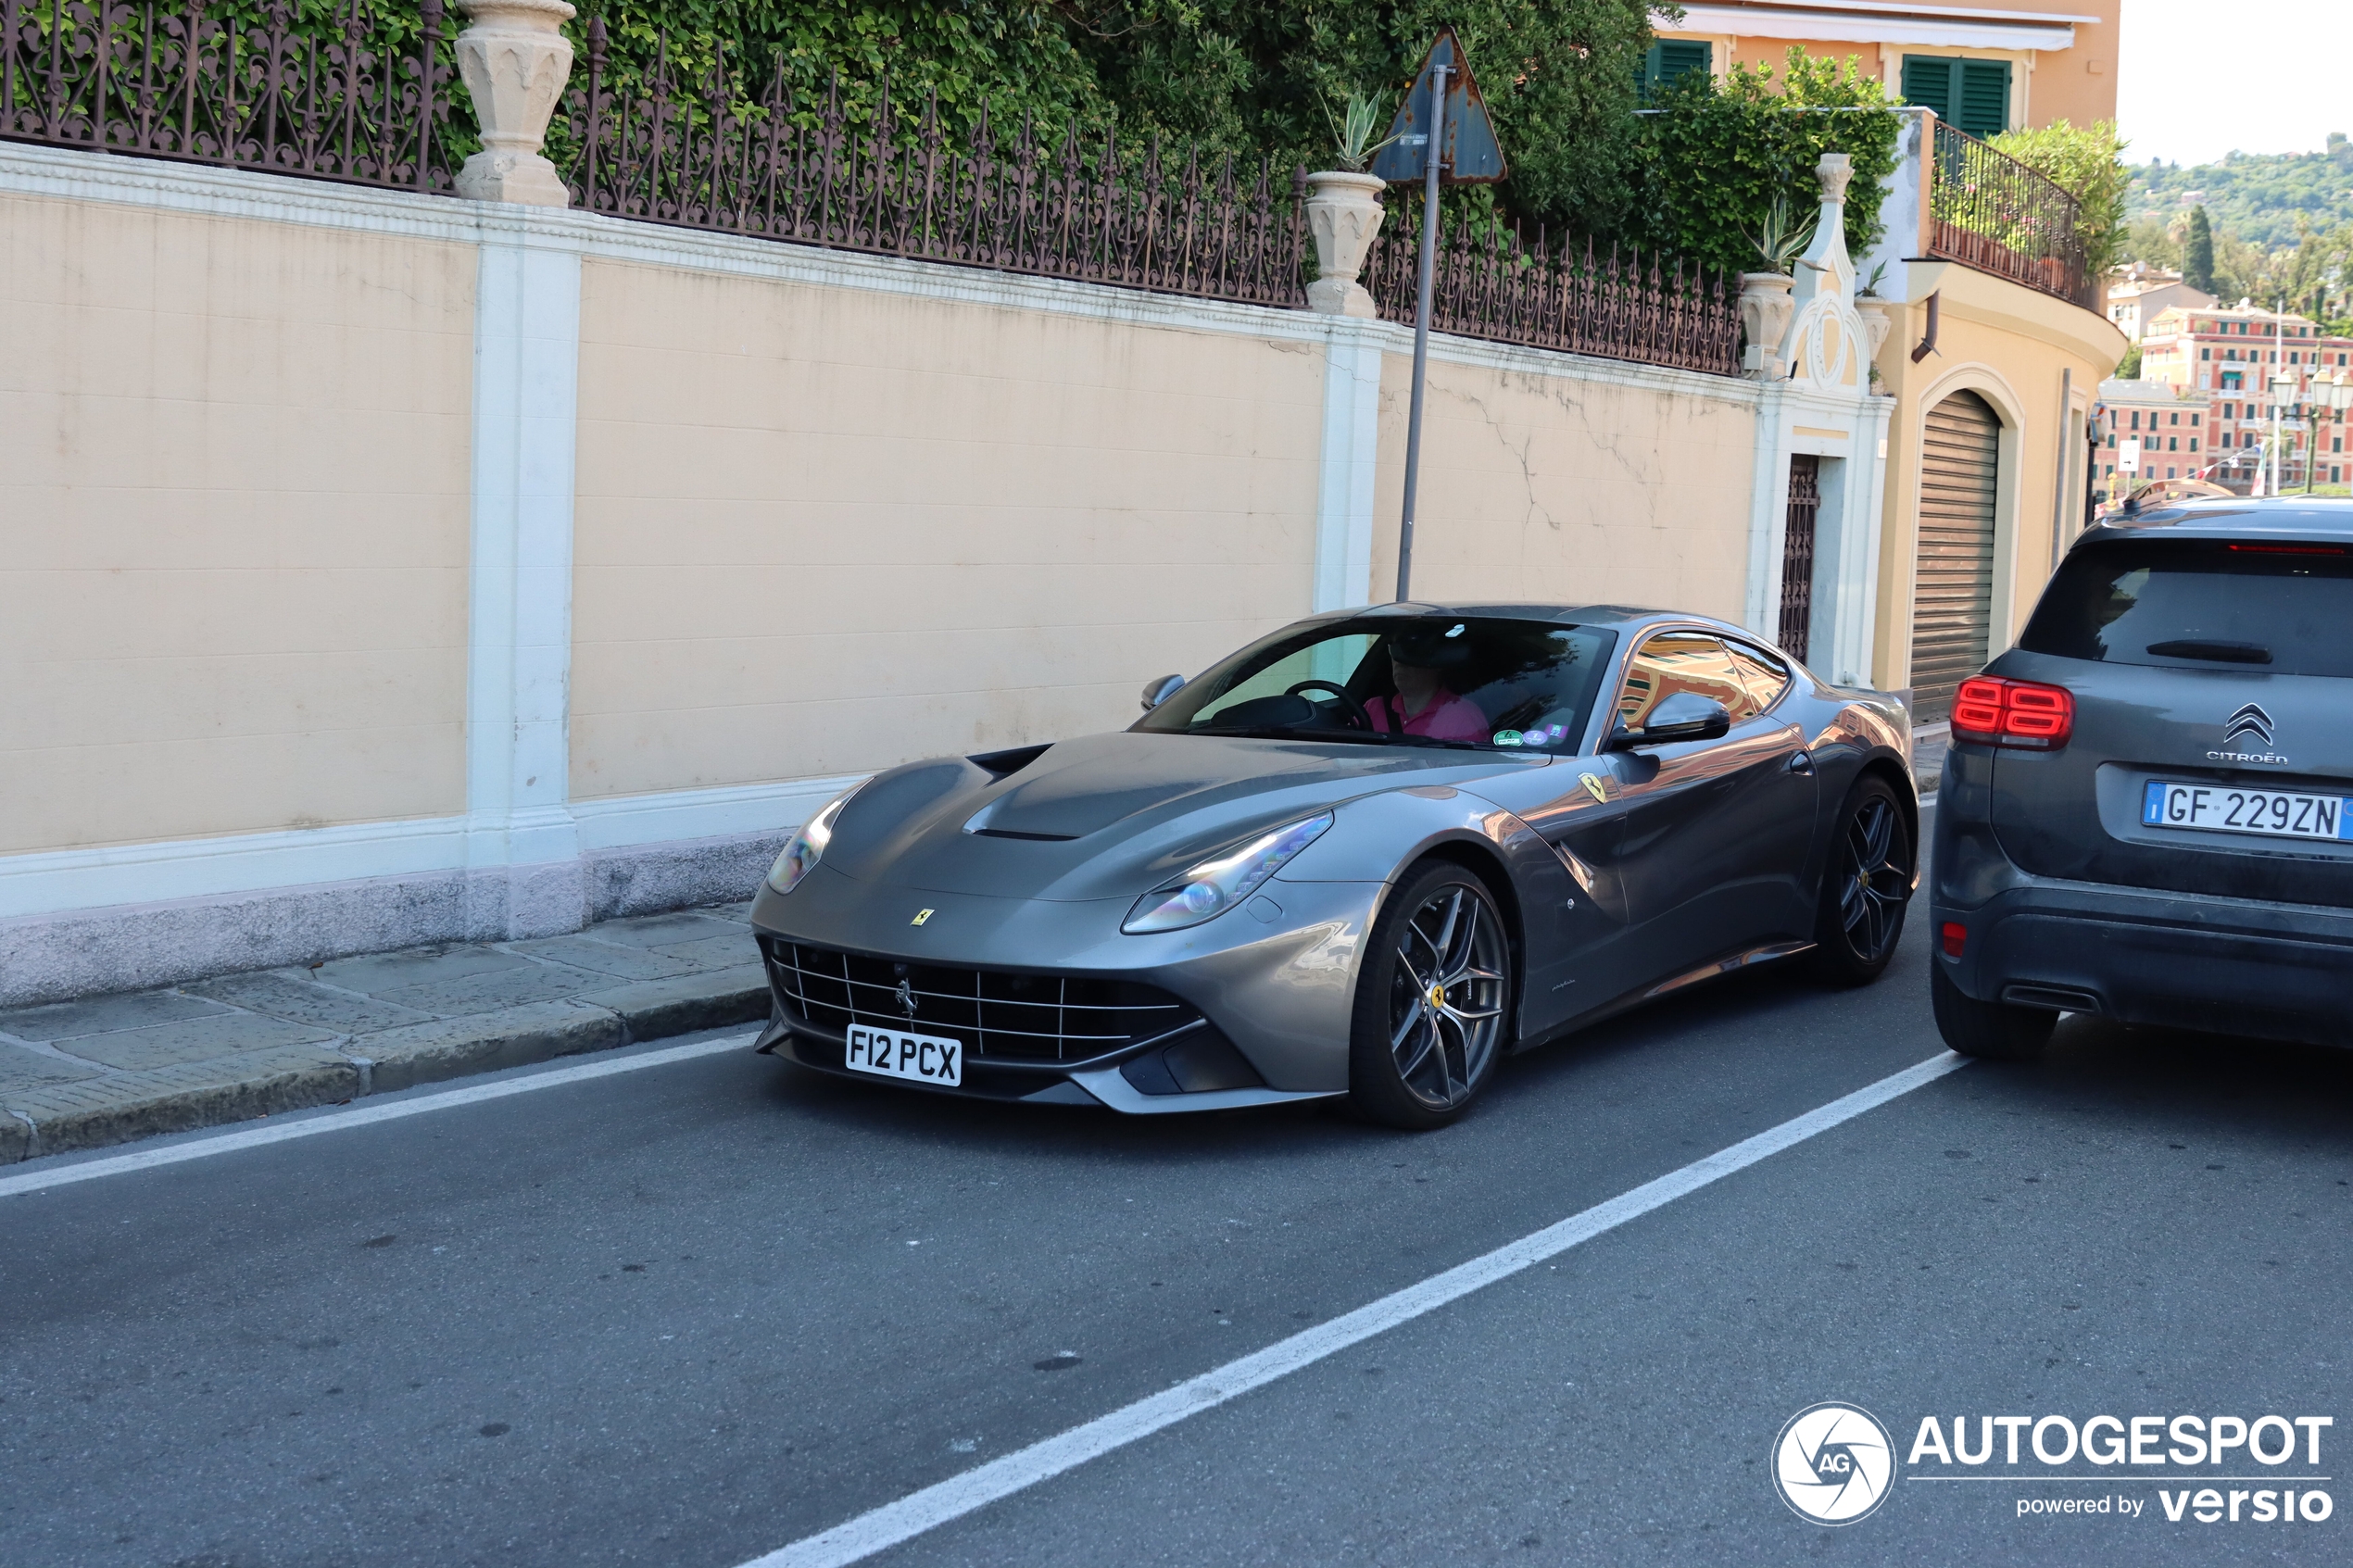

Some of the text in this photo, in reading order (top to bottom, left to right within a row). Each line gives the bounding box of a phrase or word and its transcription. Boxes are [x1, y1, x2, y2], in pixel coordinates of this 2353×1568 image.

[2169, 788, 2210, 822] GF
[2224, 793, 2336, 834] 229ZN
[850, 1030, 956, 1080] F12 PCX
